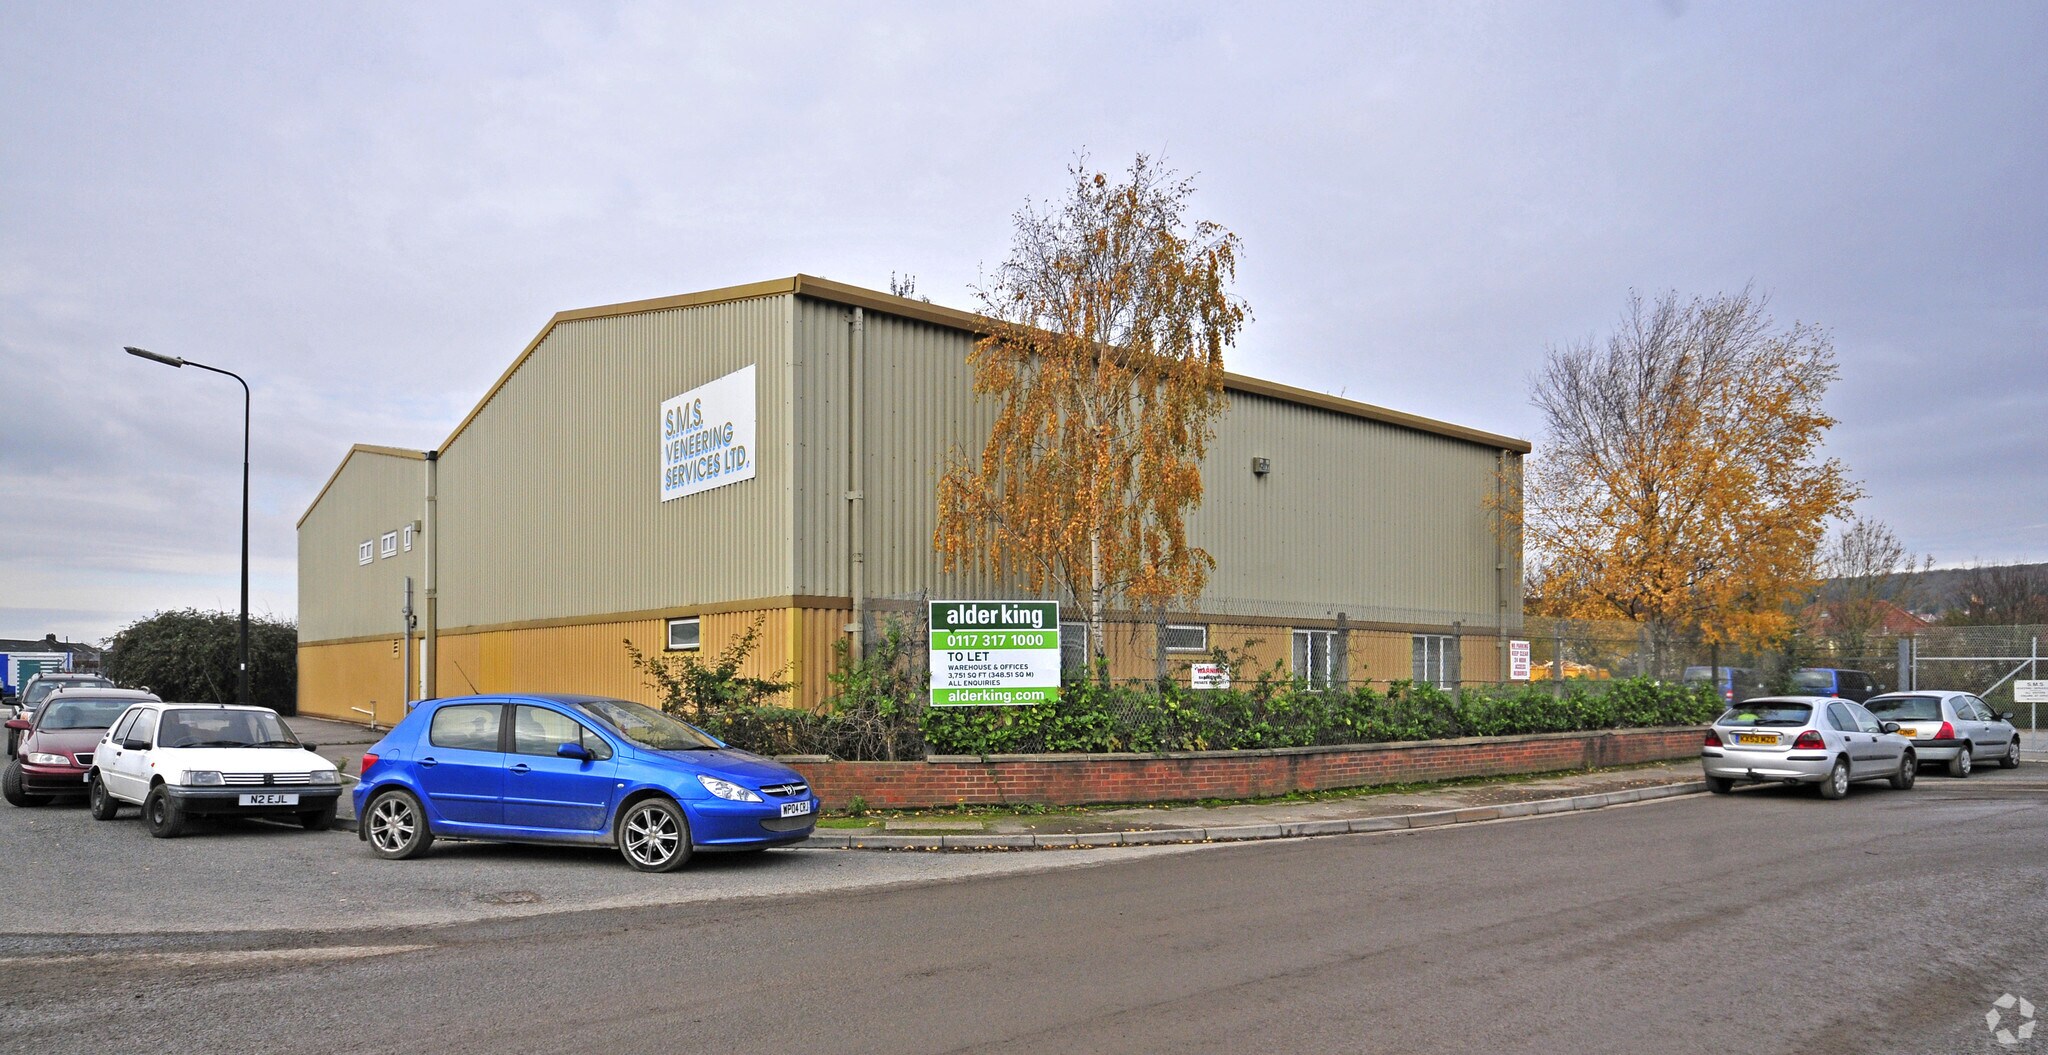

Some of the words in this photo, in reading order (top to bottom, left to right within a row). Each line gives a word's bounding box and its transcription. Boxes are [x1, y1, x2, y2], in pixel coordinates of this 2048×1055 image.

[665, 398, 704, 440] S.M.S.
[665, 421, 734, 466] VENEERING
[665, 452, 721, 491] SERVICES
[724, 445, 750, 475] LTD.
[946, 603, 999, 624] alder
[1001, 603, 1043, 629] king
[947, 634, 978, 647] 0117
[982, 634, 1006, 647] 317
[1011, 634, 1044, 646] 1000
[947, 651, 964, 662] TO
[967, 651, 990, 662] LET
[963, 679, 1001, 687] ENQUIRIES
[948, 689, 1045, 703] alderking.com
[250, 794, 265, 804] N2
[267, 794, 288, 804] EJL
[782, 803, 799, 815] WP04
